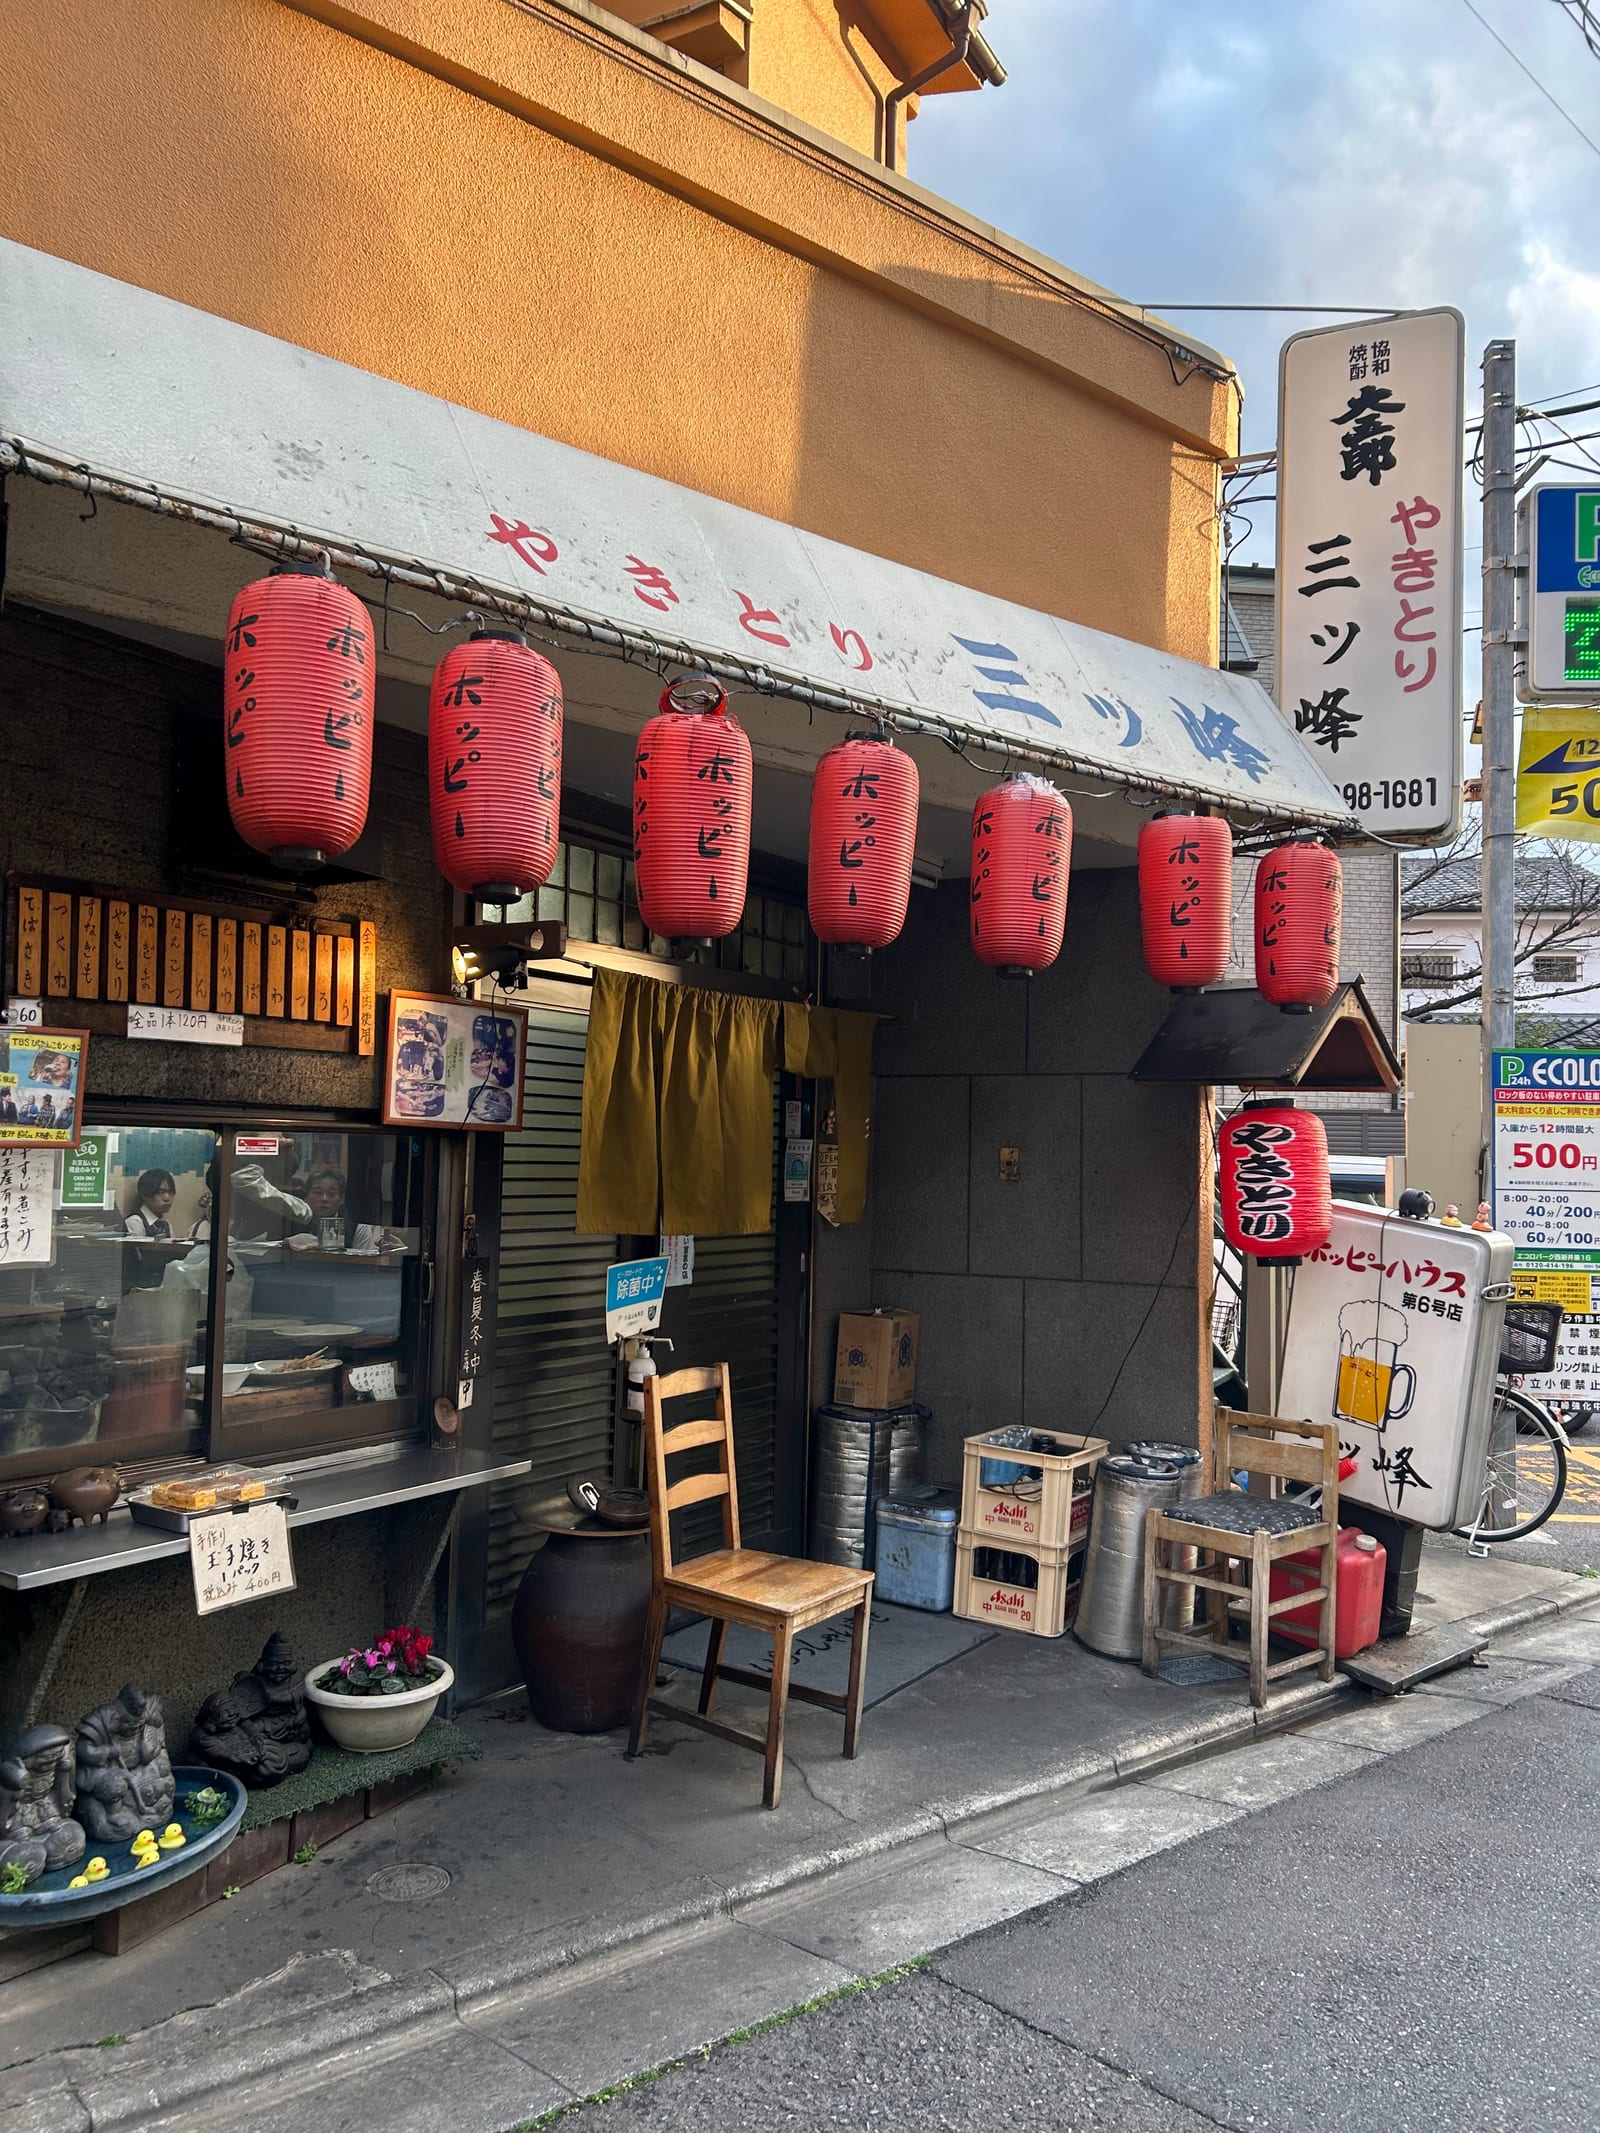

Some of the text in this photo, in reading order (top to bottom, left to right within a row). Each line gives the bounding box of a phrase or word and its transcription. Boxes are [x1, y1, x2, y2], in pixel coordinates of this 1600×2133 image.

[1348, 345, 1368, 381] 焼酎
[1371, 340, 1391, 377] 協和
[1390, 496, 1441, 692] やきとり
[485, 513, 1271, 784] やきとり 三ツ峰
[1293, 534, 1364, 754] 三ツ峰
[226, 607, 260, 798] ホッピー
[323, 615, 367, 801] ホッピー
[443, 665, 484, 838] ホッピー
[1334, 777, 1437, 811] 98-1681
[697, 745, 735, 900] ホッピー
[839, 764, 881, 907] ホッピー
[971, 807, 994, 936] ホッピー
[1032, 807, 1064, 937] ホッピー
[1167, 834, 1201, 960] ホッピー
[23, 896, 38, 990] てばさき
[54, 905, 68, 989] つくね
[82, 898, 97, 984] すなぎも
[112, 908, 127, 999] やきとり
[1261, 866, 1289, 976] ホッピー
[1231, 1121, 1297, 1242] やきとり
[1513, 1142, 1598, 1170] 500円
[616, 1274, 656, 1301] 除菌中
[1303, 1242, 1467, 1299] ホッピーハウス
[1401, 1291, 1464, 1323] 第6号店
[470, 1267, 487, 1375] 春夏冬中
[196, 1527, 226, 1551] 手作り
[207, 1537, 271, 1571] 玉子焼き
[993, 1501, 1028, 1519] Asahi
[990, 1589, 1025, 1608] Asahi
[1020, 1610, 1031, 1622] 20
